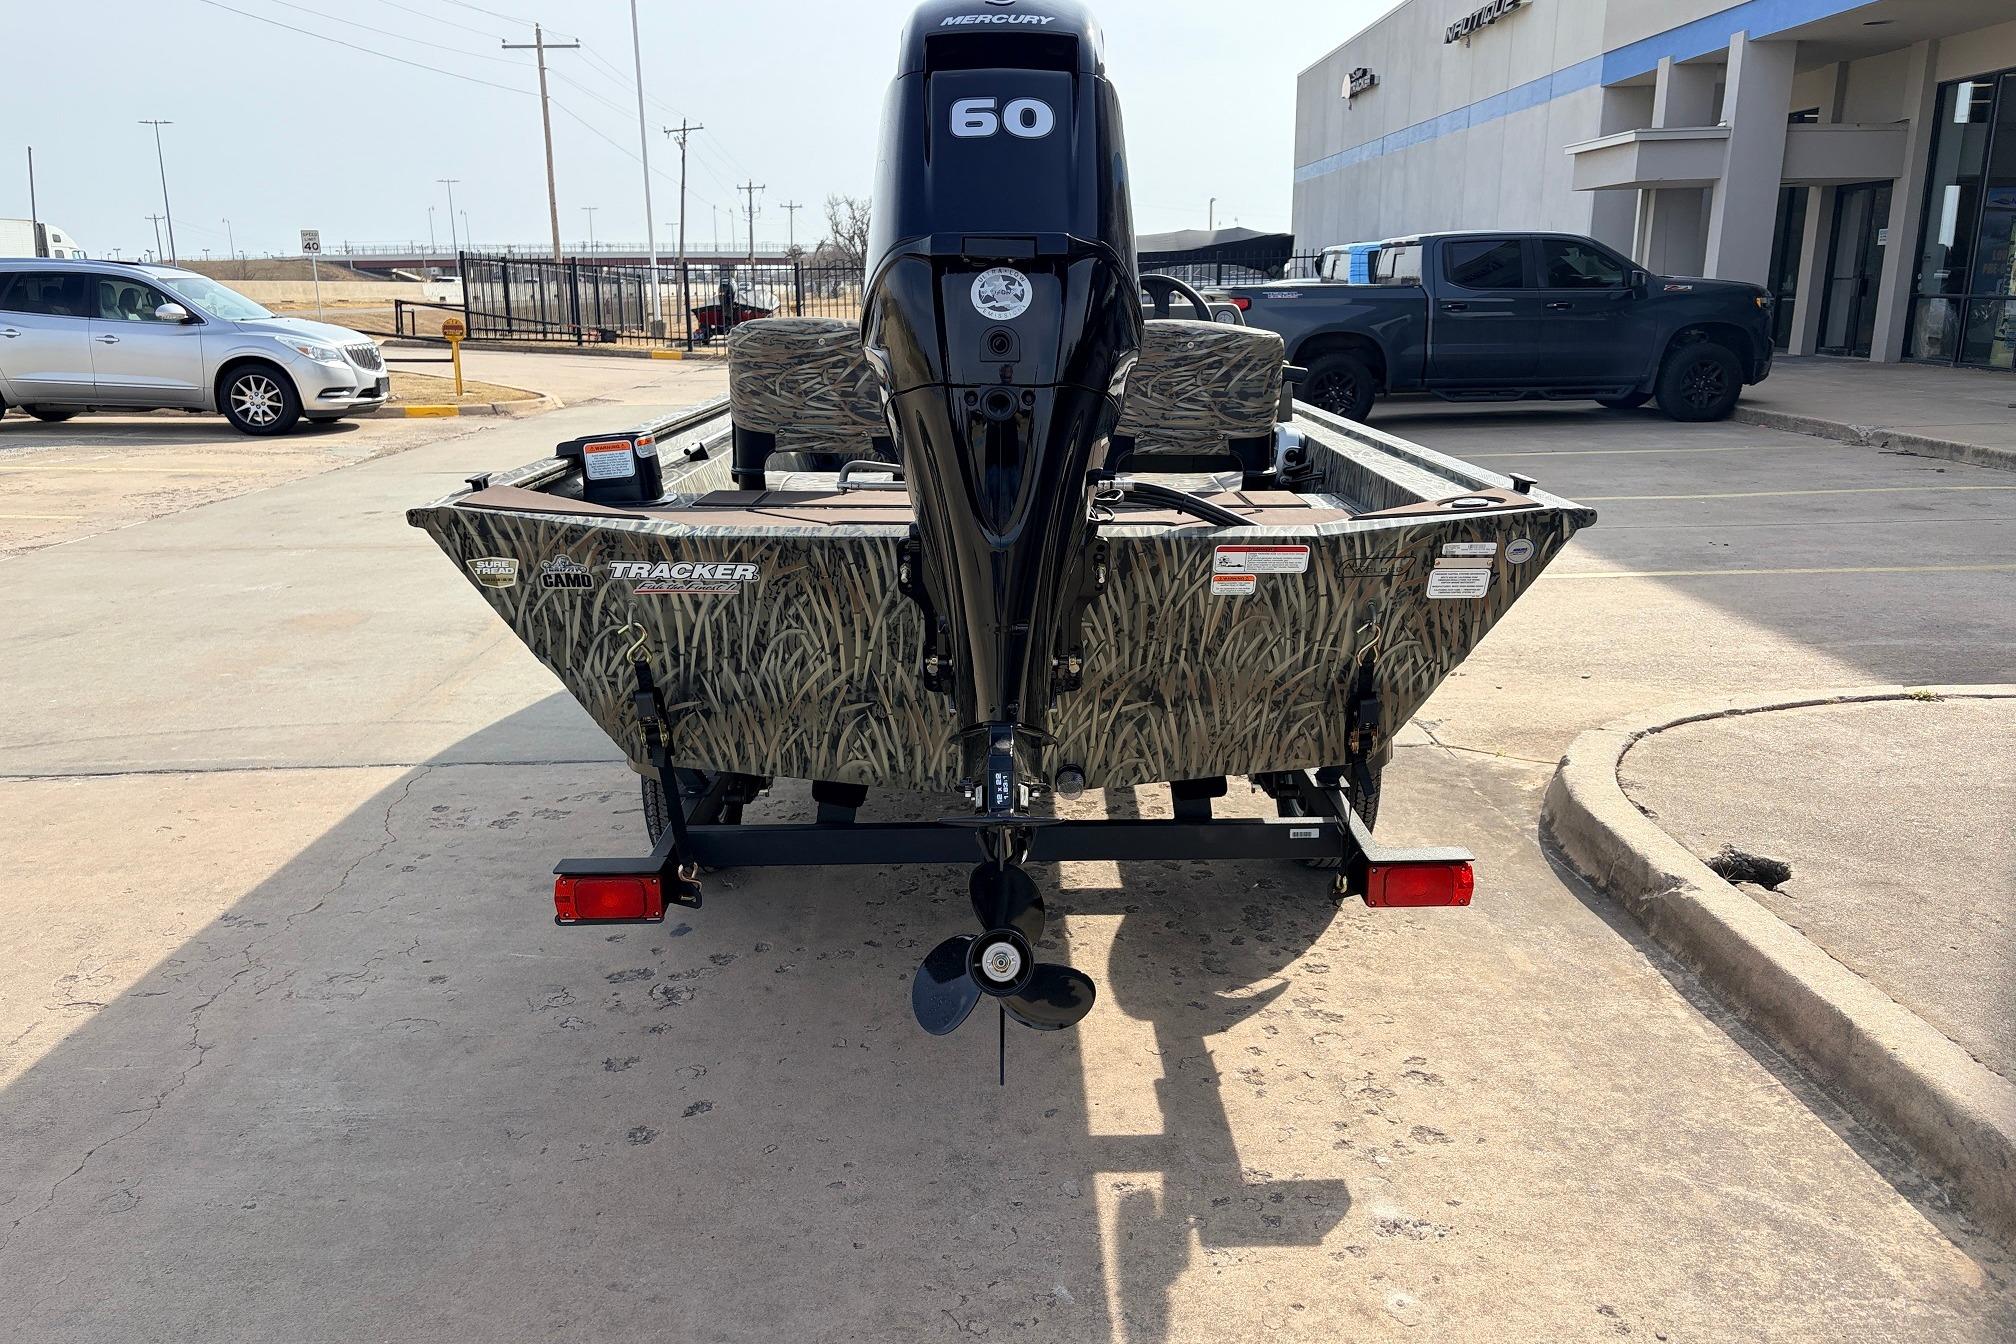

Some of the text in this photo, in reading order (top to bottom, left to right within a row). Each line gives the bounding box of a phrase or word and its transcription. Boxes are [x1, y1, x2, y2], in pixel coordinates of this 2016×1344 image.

[940, 14, 1056, 26] MERCURY
[949, 97, 1056, 139] 60
[304, 242, 319, 250] 40
[474, 567, 515, 575] TREAD
[610, 562, 758, 580] TRACKER
[543, 573, 593, 588] CAMO
[639, 582, 665, 591] Fish
[665, 582, 685, 591] the
[996, 773, 1002, 785] 22
[997, 794, 1003, 804] 12
